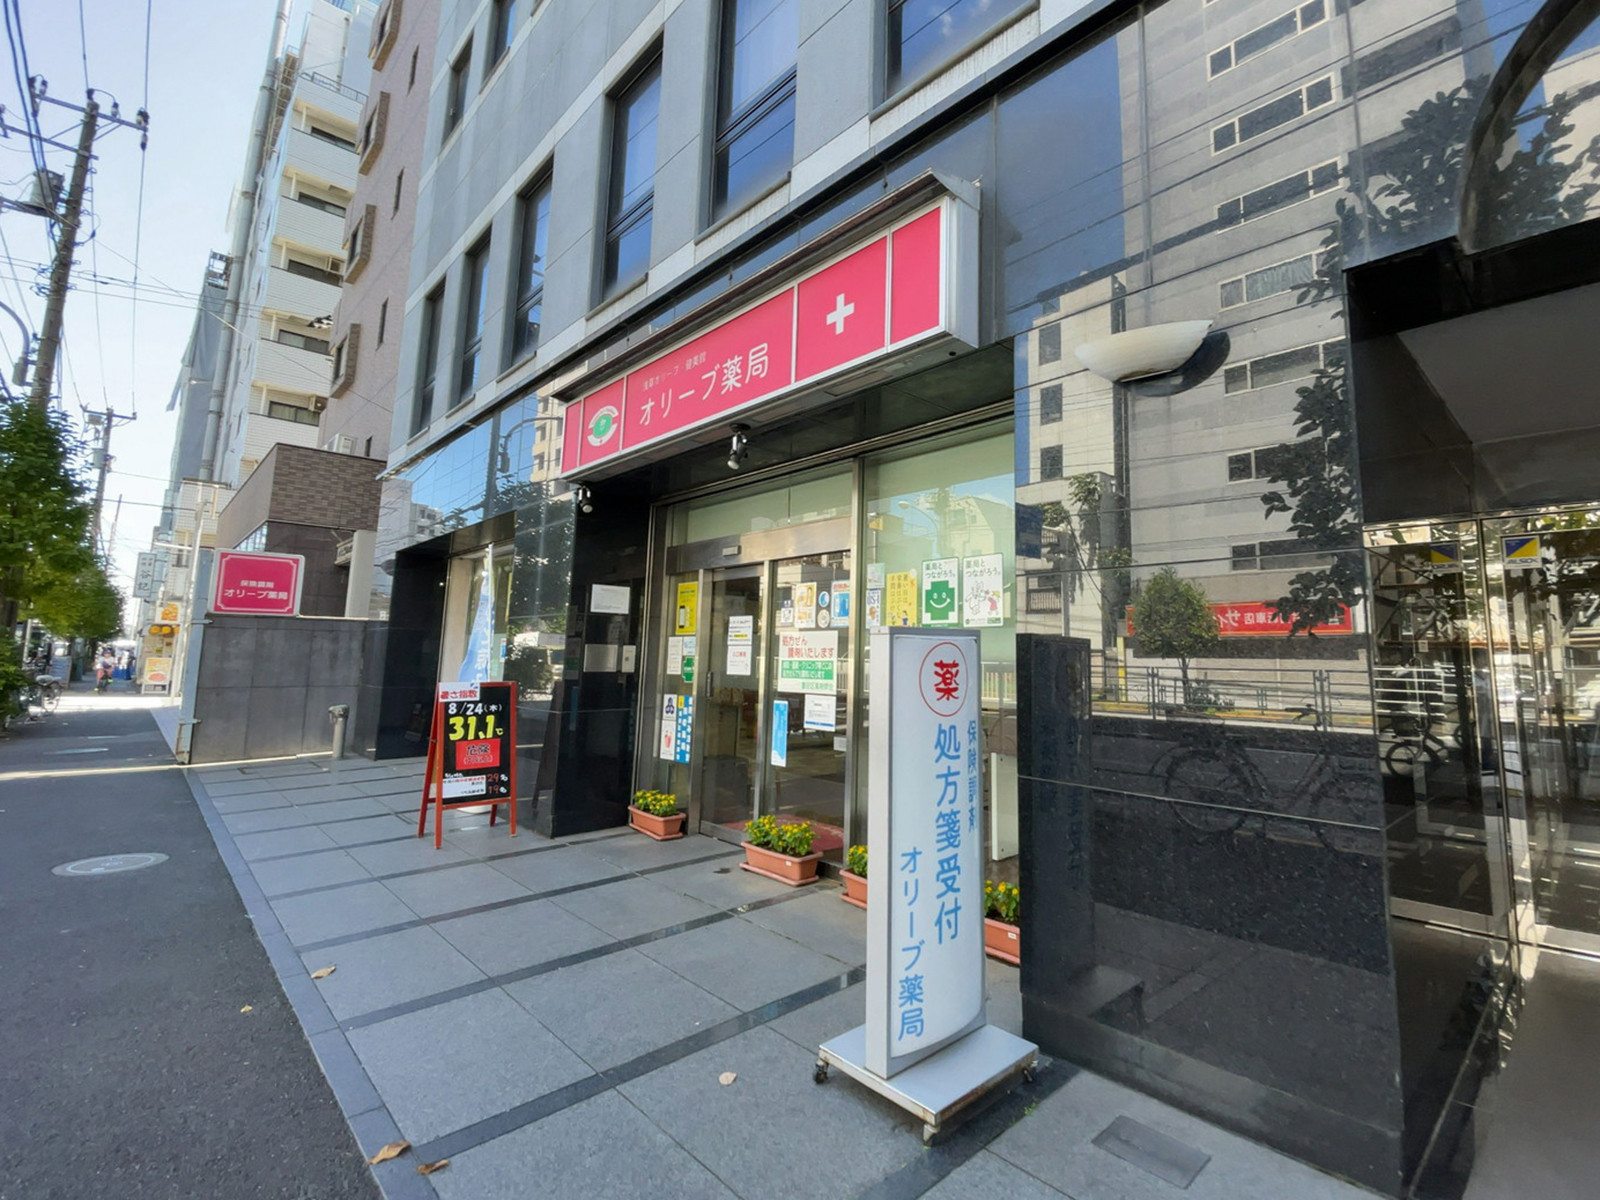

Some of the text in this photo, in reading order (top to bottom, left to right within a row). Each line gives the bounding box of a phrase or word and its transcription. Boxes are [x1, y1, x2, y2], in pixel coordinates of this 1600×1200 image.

[639, 342, 769, 426] オリーブ薬局
[223, 588, 289, 600] オリーブ薬局
[933, 660, 960, 701] 薬
[934, 724, 962, 945] 処方箋受付
[898, 847, 925, 1041] オリーブ薬局
